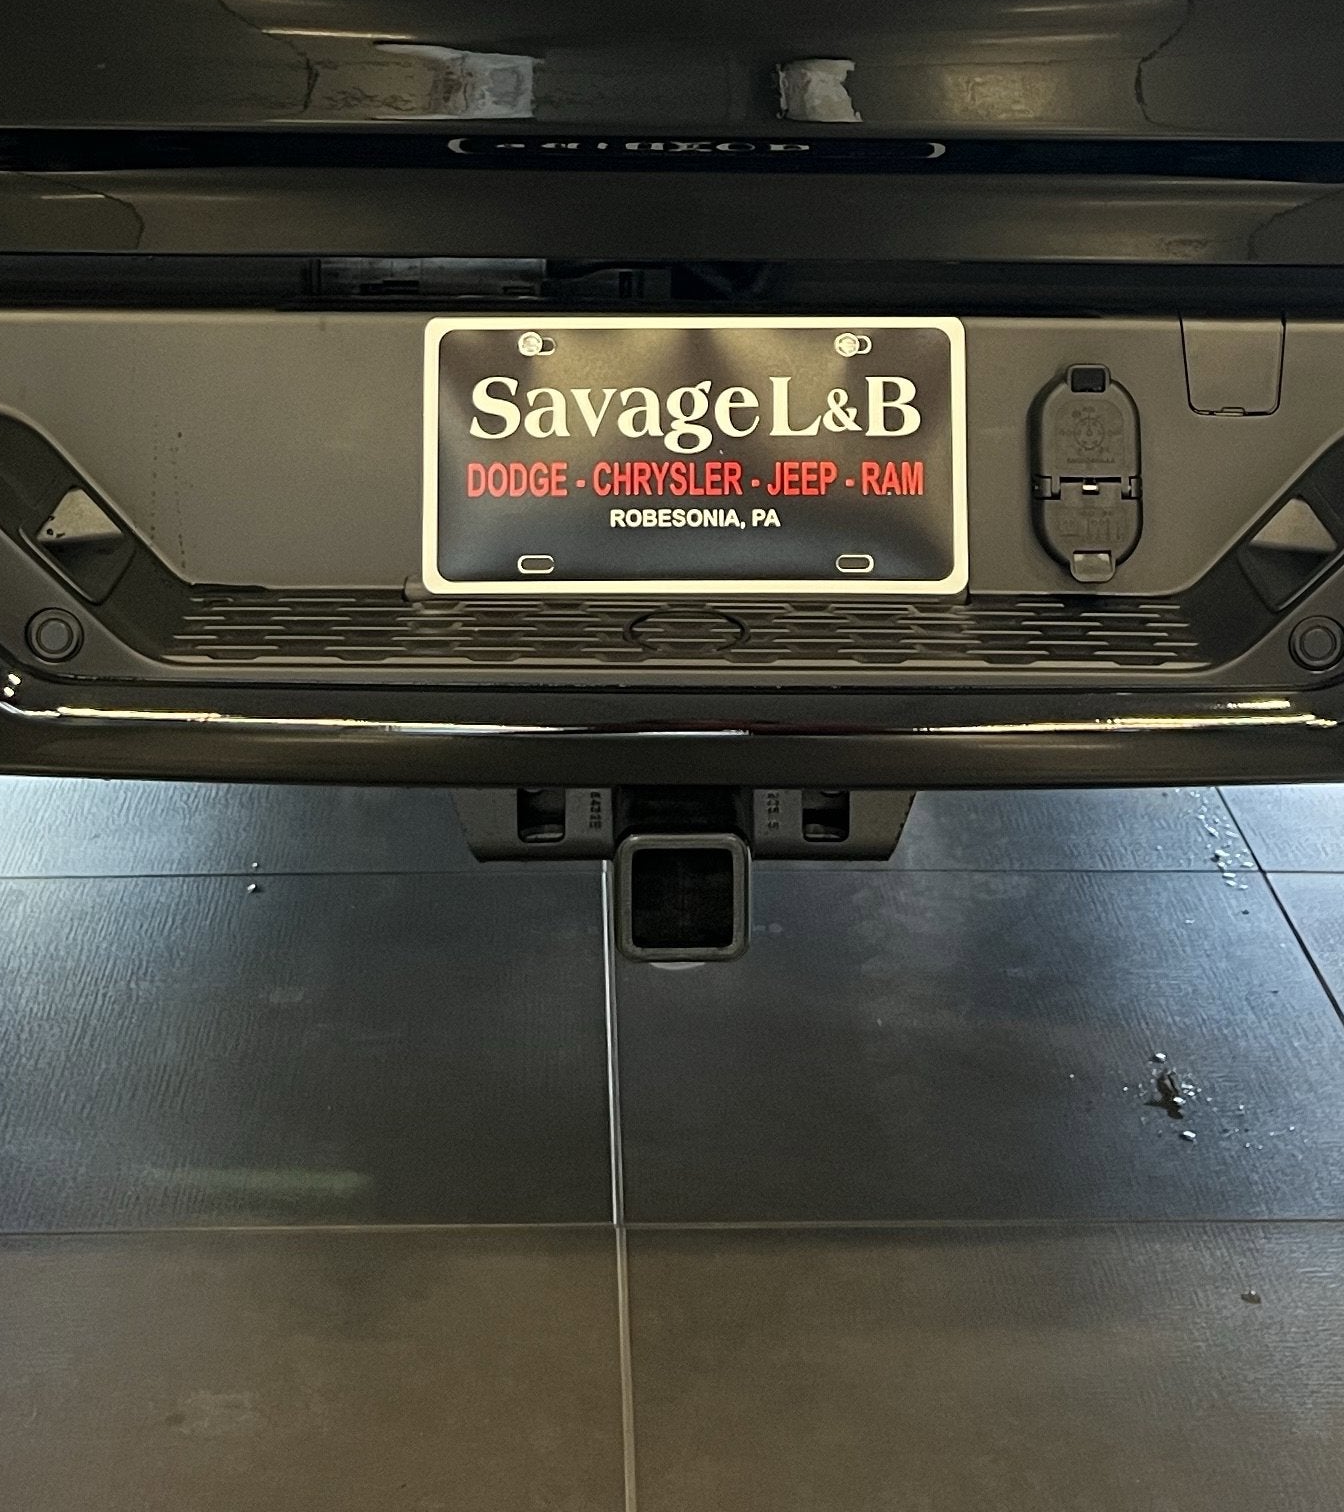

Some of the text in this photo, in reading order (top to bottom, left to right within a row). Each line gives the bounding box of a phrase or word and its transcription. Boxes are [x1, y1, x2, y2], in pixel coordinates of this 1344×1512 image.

[467, 462, 568, 498] DODGE
[592, 461, 744, 497] CHRYSLER
[767, 461, 838, 496] JEEP
[861, 461, 924, 496] RAM
[609, 508, 781, 530] ROBESONIA, PA
